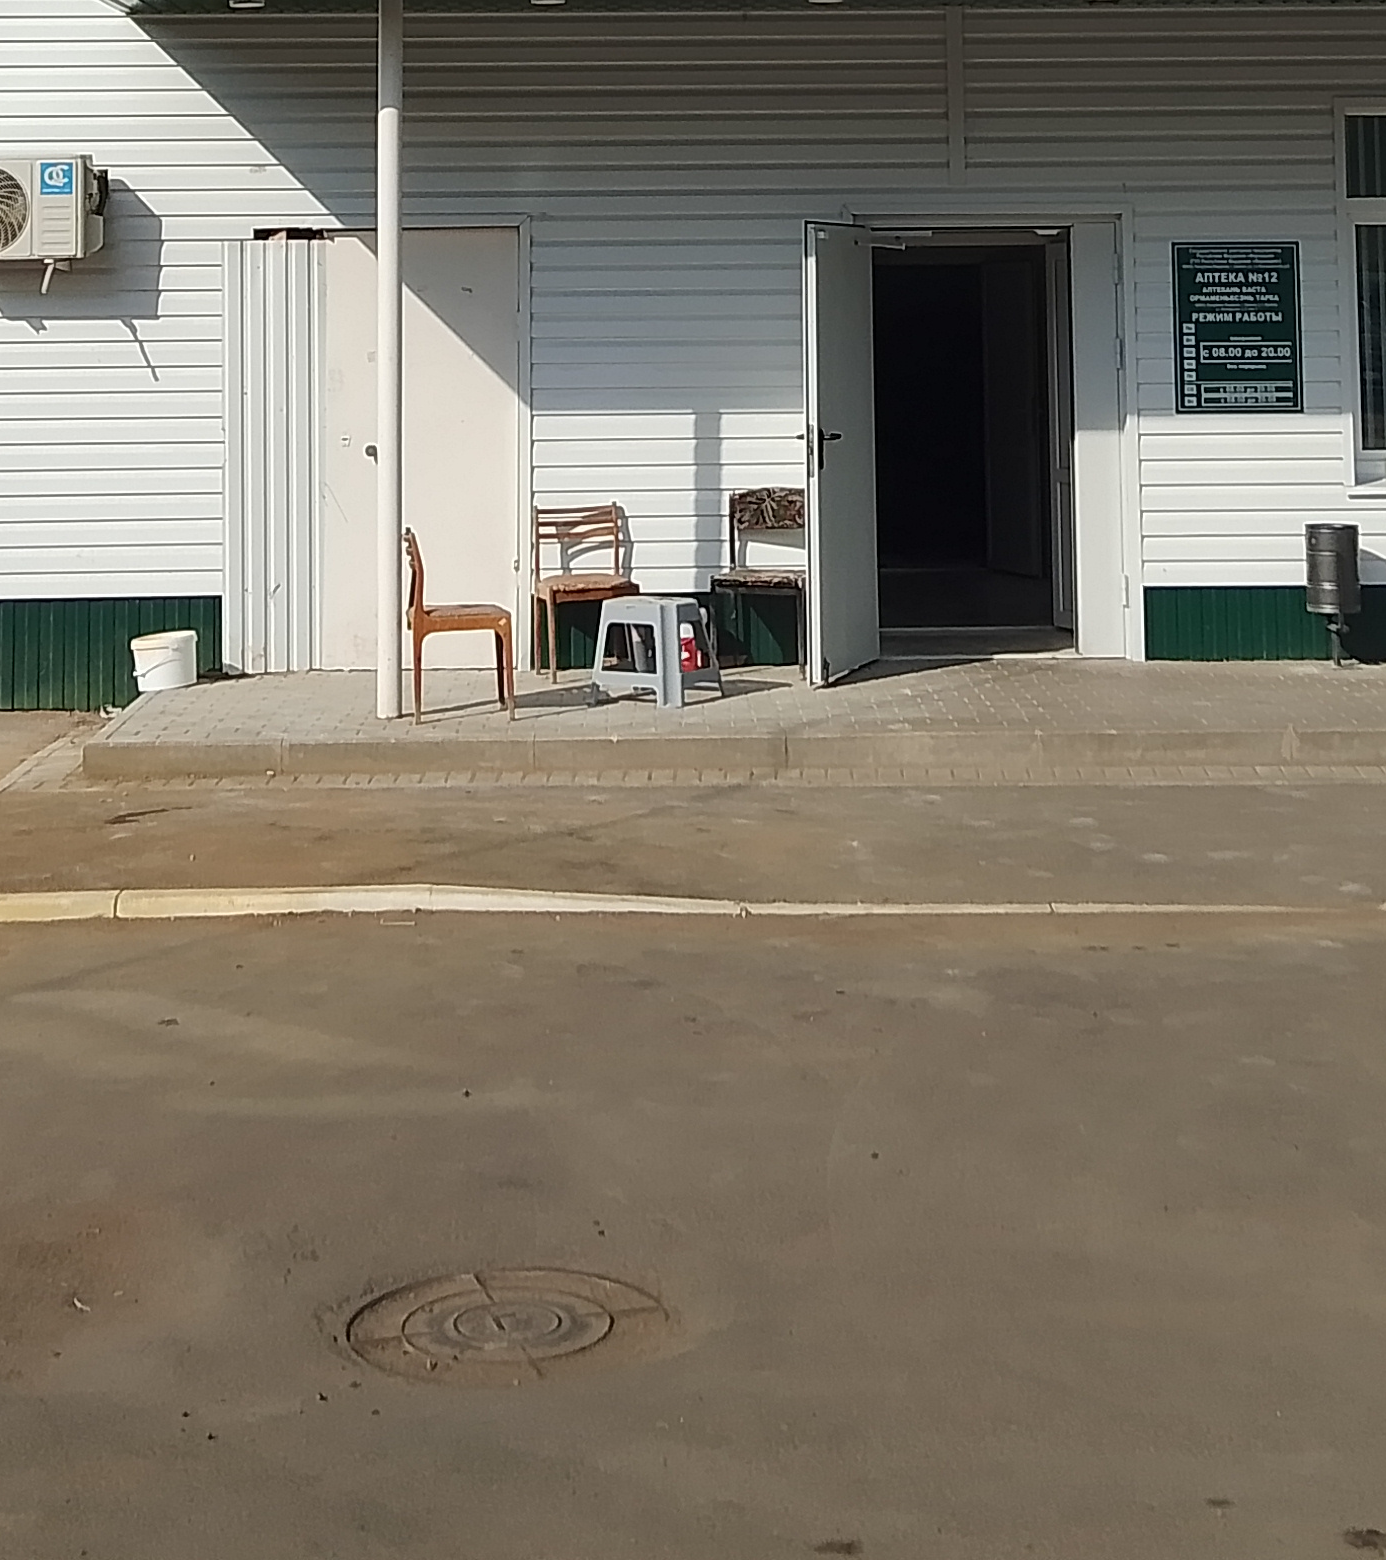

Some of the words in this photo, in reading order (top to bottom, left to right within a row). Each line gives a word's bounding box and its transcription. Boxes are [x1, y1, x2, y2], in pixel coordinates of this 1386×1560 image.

[1195, 272, 1245, 283] АПТЕКА
[1248, 272, 1279, 283] №12
[1192, 312, 1233, 322] РЕЖИМ
[1235, 312, 1283, 322] РАБОТЫ
[1212, 347, 1242, 357] 08.00
[1244, 349, 1259, 358] до
[1261, 347, 1291, 357] 20.00
